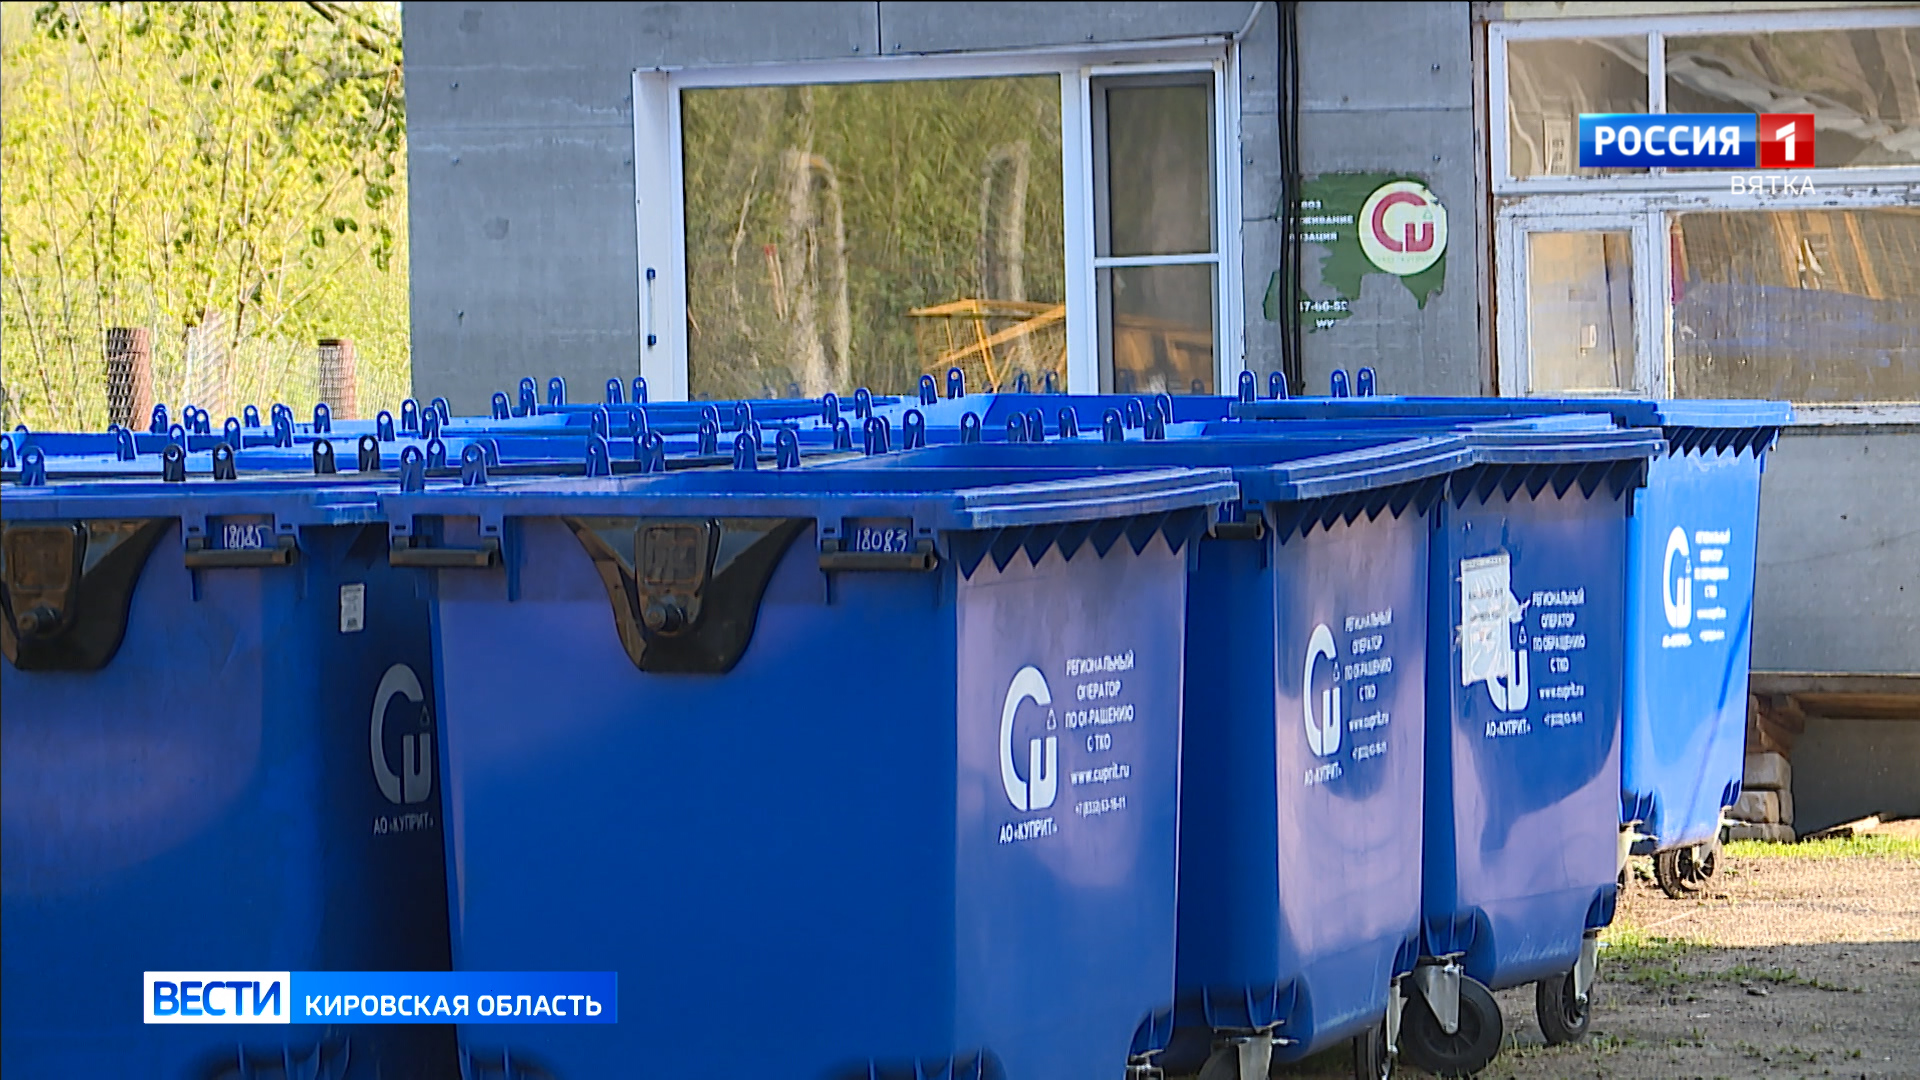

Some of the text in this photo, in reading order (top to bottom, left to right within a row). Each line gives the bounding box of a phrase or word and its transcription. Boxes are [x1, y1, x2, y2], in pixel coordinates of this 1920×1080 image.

[224, 524, 272, 549] 18085
[855, 527, 908, 552] 18083
[1065, 711, 1077, 728] ПО
[1095, 733, 1111, 751] ТКО
[373, 815, 388, 836] АО
[999, 823, 1013, 844] АО
